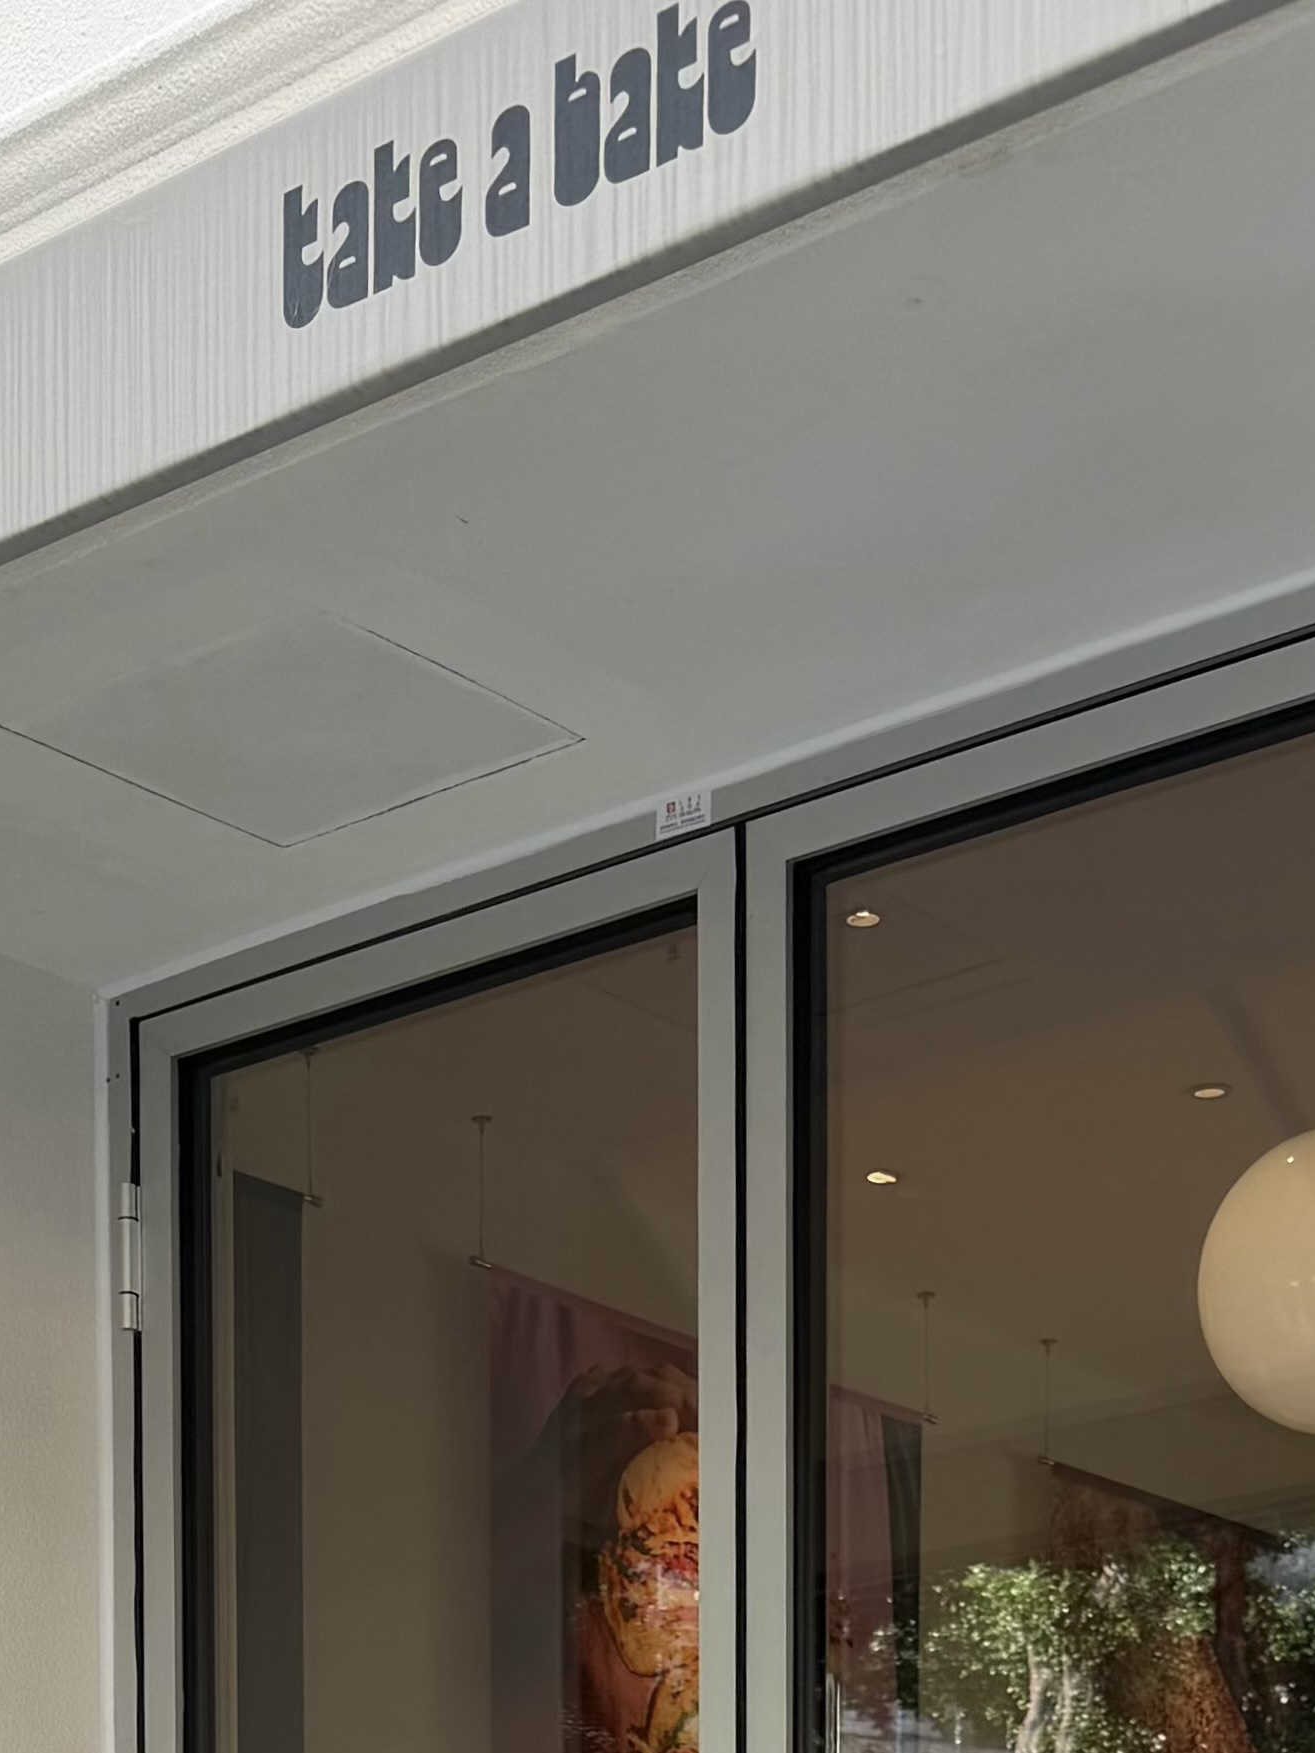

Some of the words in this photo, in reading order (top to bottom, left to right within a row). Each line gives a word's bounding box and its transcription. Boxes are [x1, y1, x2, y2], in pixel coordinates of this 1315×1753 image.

[283, 138, 463, 329] take
[485, 104, 531, 237] a
[554, 0, 757, 207] bake
